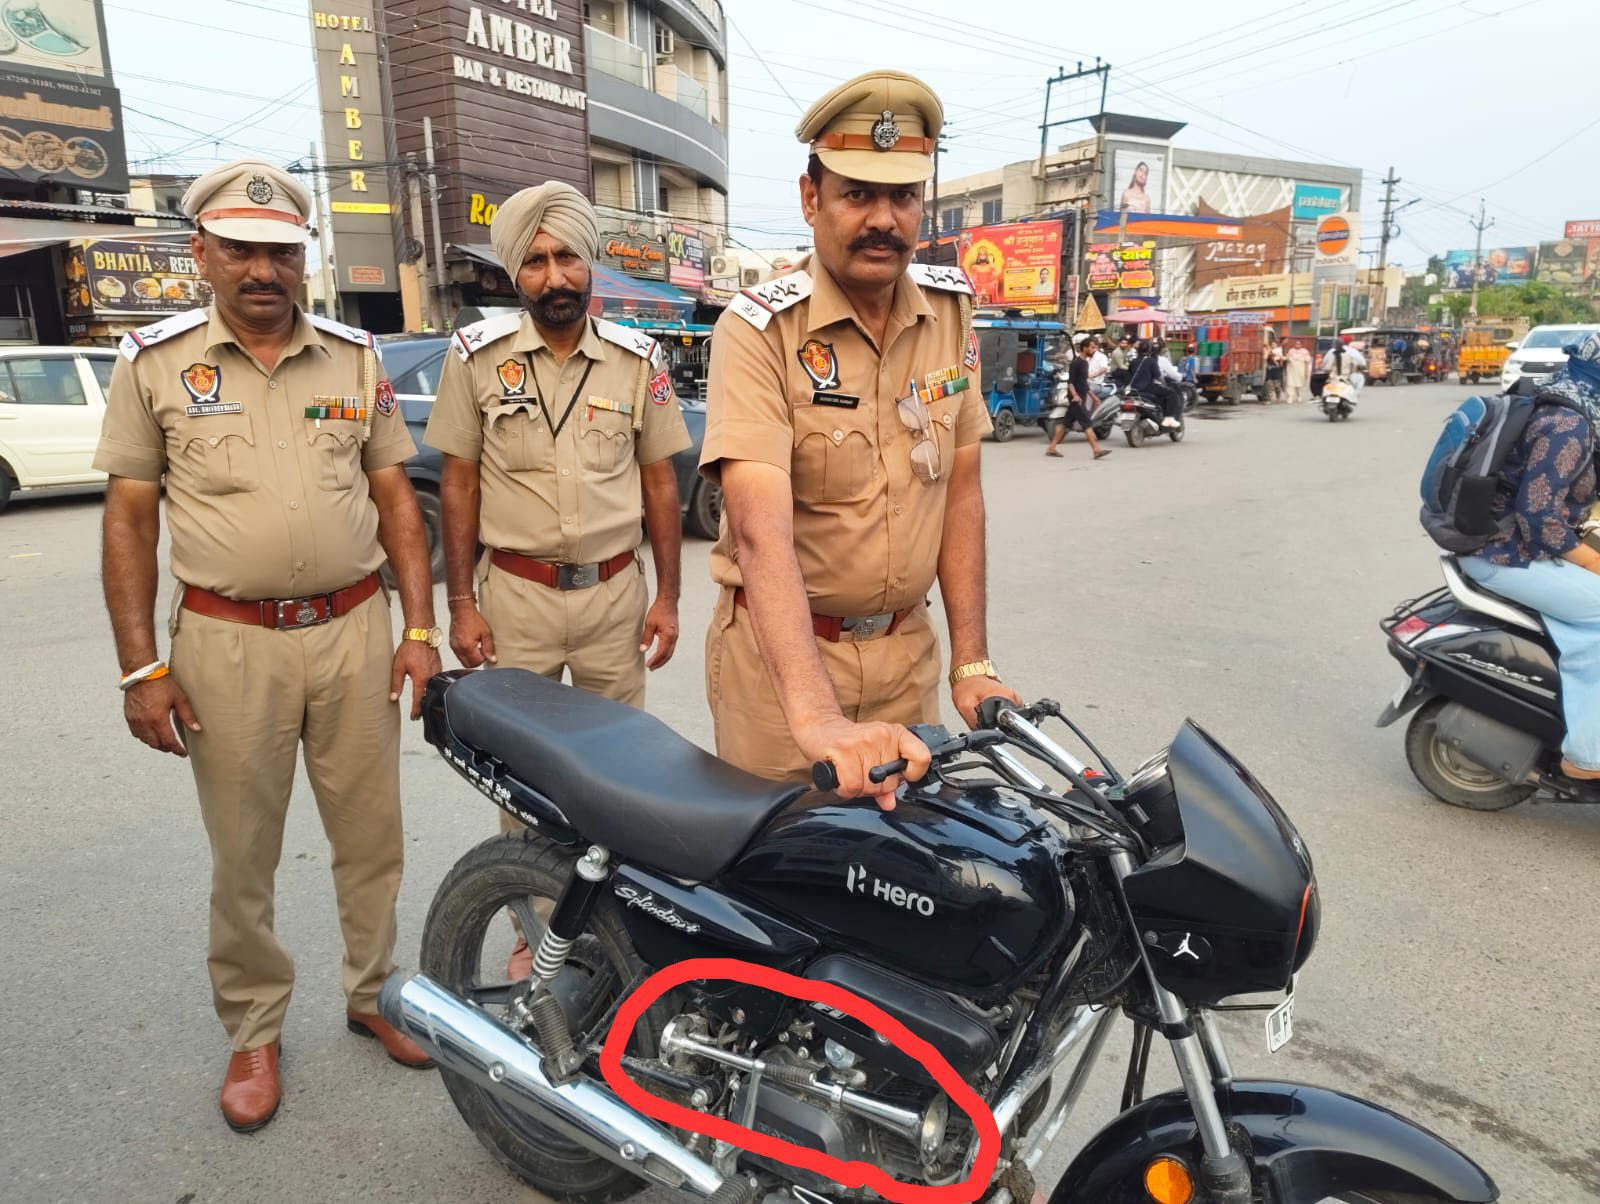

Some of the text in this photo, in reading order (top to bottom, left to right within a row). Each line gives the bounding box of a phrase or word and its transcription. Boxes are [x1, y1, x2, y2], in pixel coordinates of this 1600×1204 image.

[315, 12, 373, 32] HOTEL
[465, 7, 573, 74] AMBER
[453, 56, 587, 110] BAR & RESTAURANT
[340, 43, 368, 192] AMBER
[93, 251, 153, 272] BHATIA
[873, 878, 936, 917] Hero
